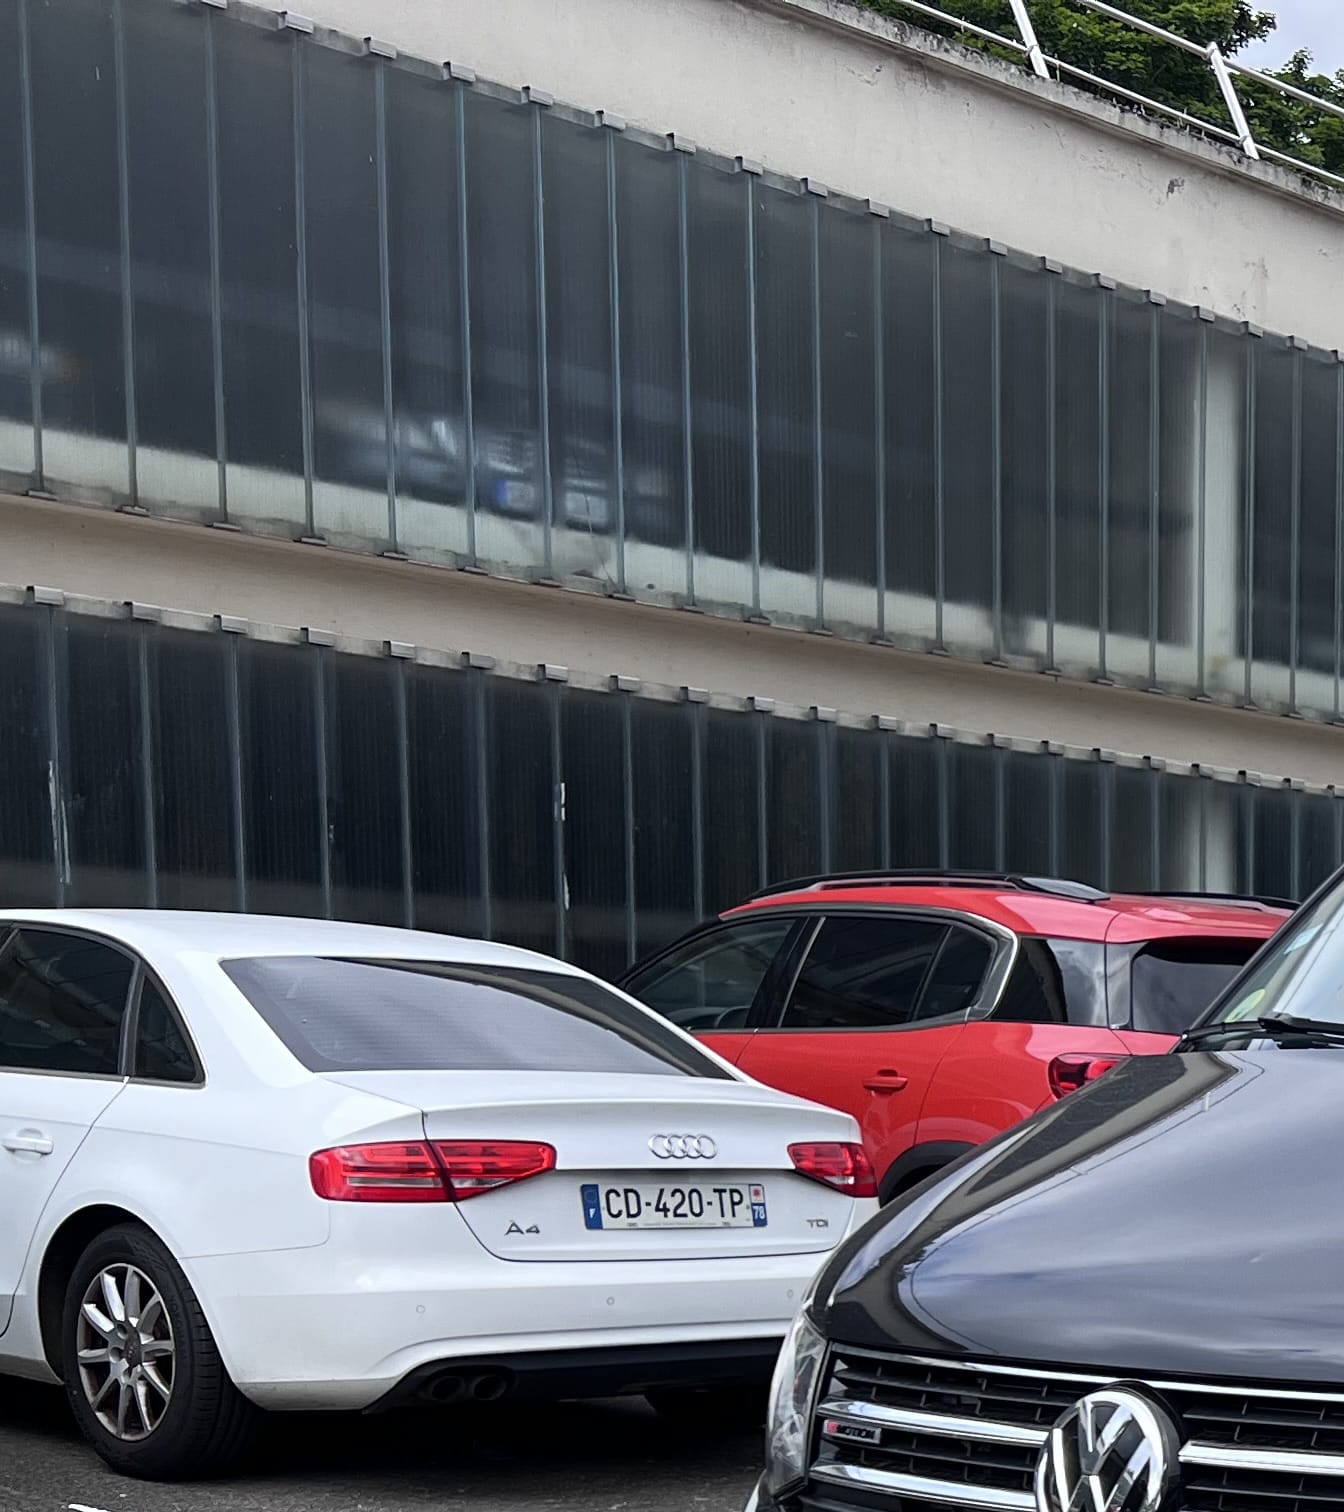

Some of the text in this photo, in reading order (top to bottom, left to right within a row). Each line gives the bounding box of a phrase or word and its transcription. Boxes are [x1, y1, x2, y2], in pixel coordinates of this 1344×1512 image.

[604, 1187, 745, 1220] CD-420-TP
[589, 1208, 596, 1219] F
[752, 1205, 766, 1220] 78
[504, 1221, 540, 1236] A4
[806, 1218, 829, 1229] TDI
